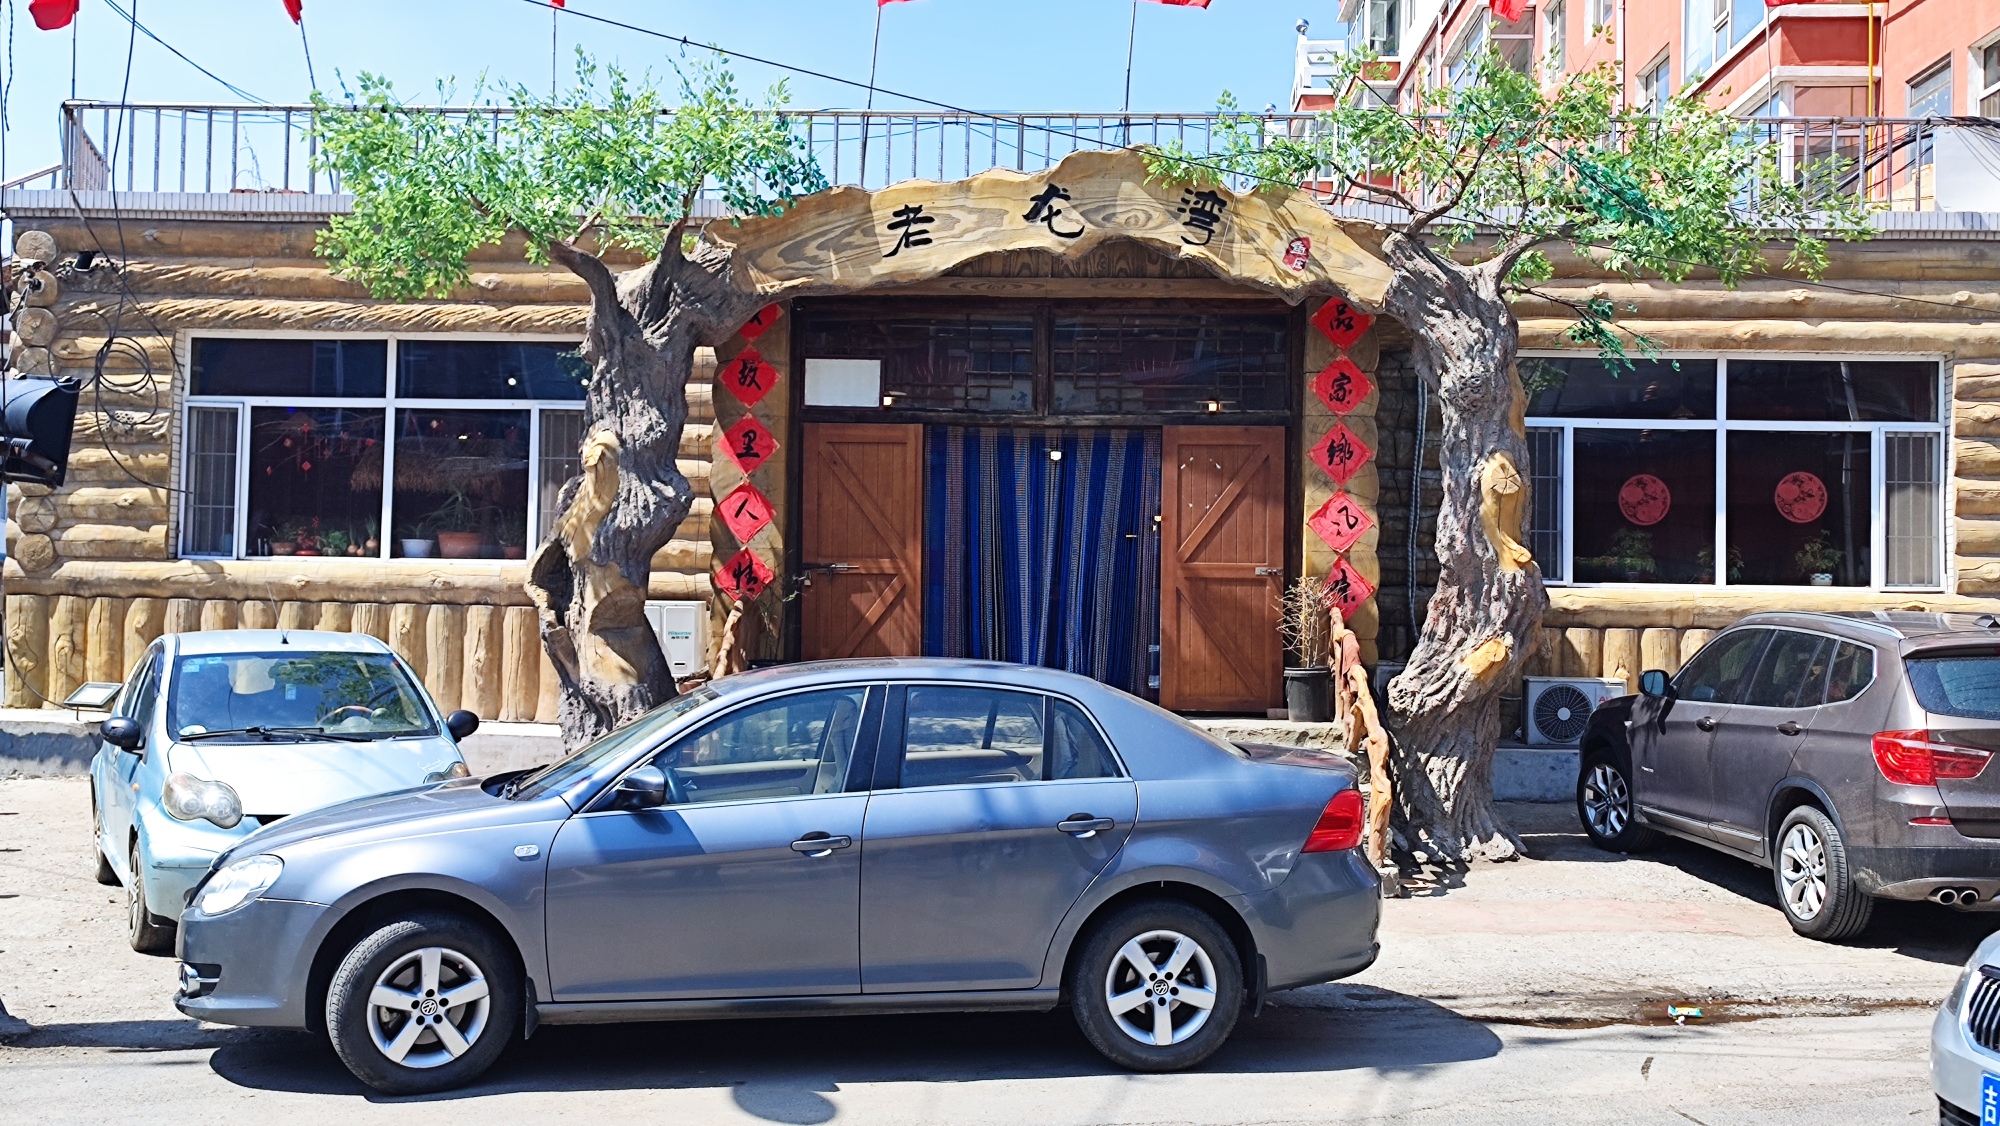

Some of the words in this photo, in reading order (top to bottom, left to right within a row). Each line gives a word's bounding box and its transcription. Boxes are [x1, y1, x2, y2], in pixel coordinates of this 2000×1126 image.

[883, 184, 1227, 257] 老龙湾
[732, 310, 762, 593] 故里人情
